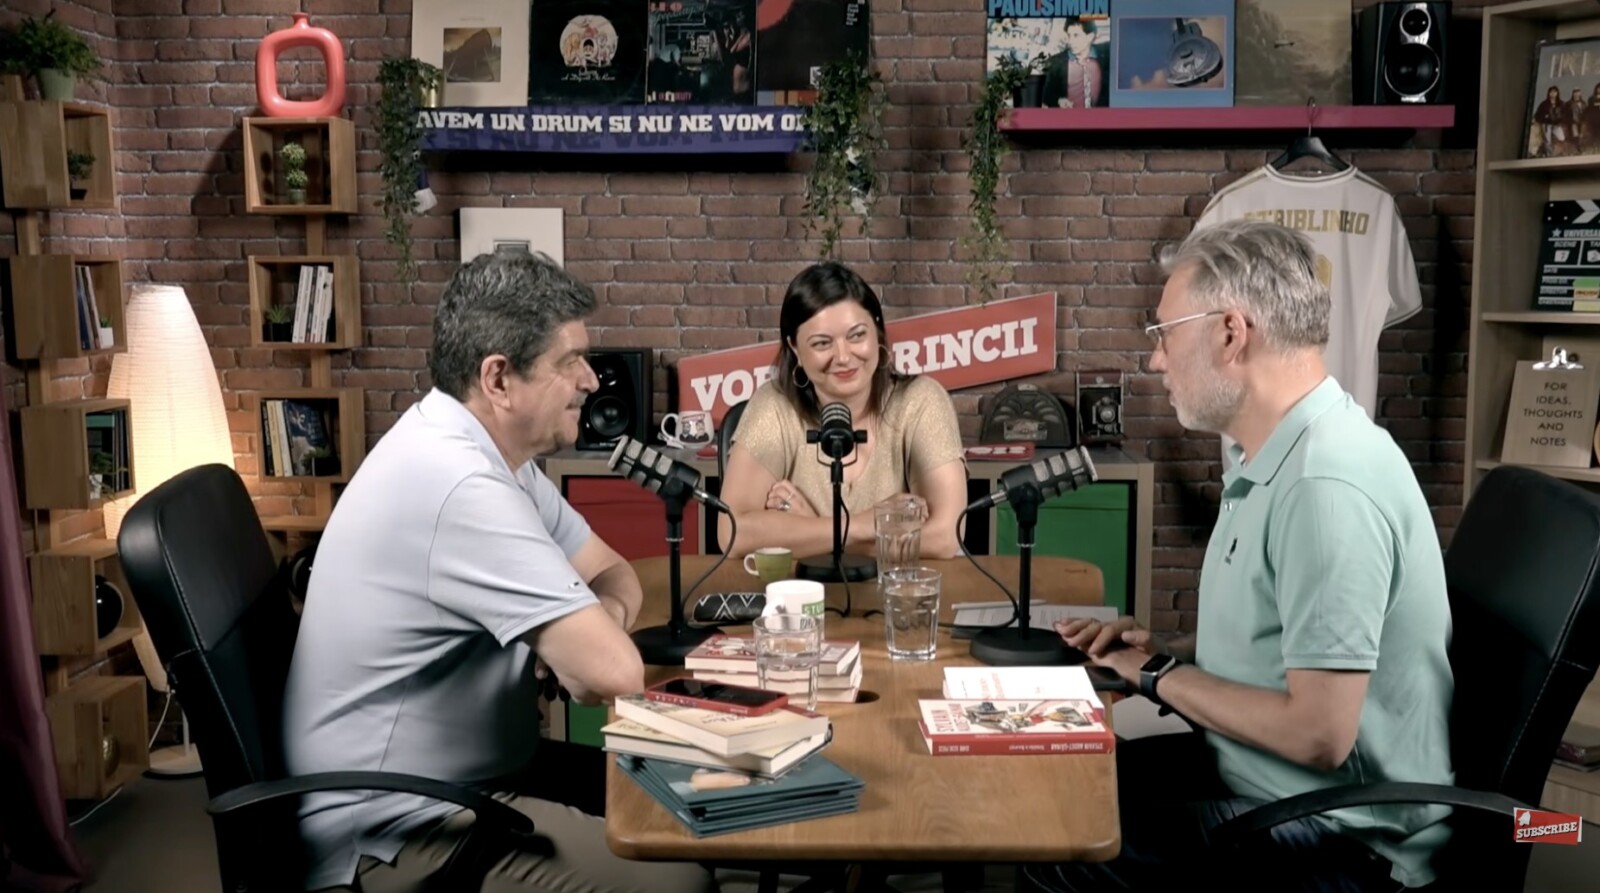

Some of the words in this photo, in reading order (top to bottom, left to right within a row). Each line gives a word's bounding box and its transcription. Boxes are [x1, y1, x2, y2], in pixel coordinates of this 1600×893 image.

[416, 111, 484, 129] AVEM
[490, 113, 525, 131] UN
[531, 115, 602, 132] DRUM
[609, 115, 632, 133] SI
[638, 115, 673, 133] NU
[679, 114, 713, 131] NE
[719, 114, 774, 131] VOM
[892, 316, 1038, 376] RINCII
[1544, 382, 1568, 391] FOR
[1523, 408, 1584, 419] THOUGHTS
[1537, 422, 1565, 431] AND
[1530, 437, 1567, 447] NOTES
